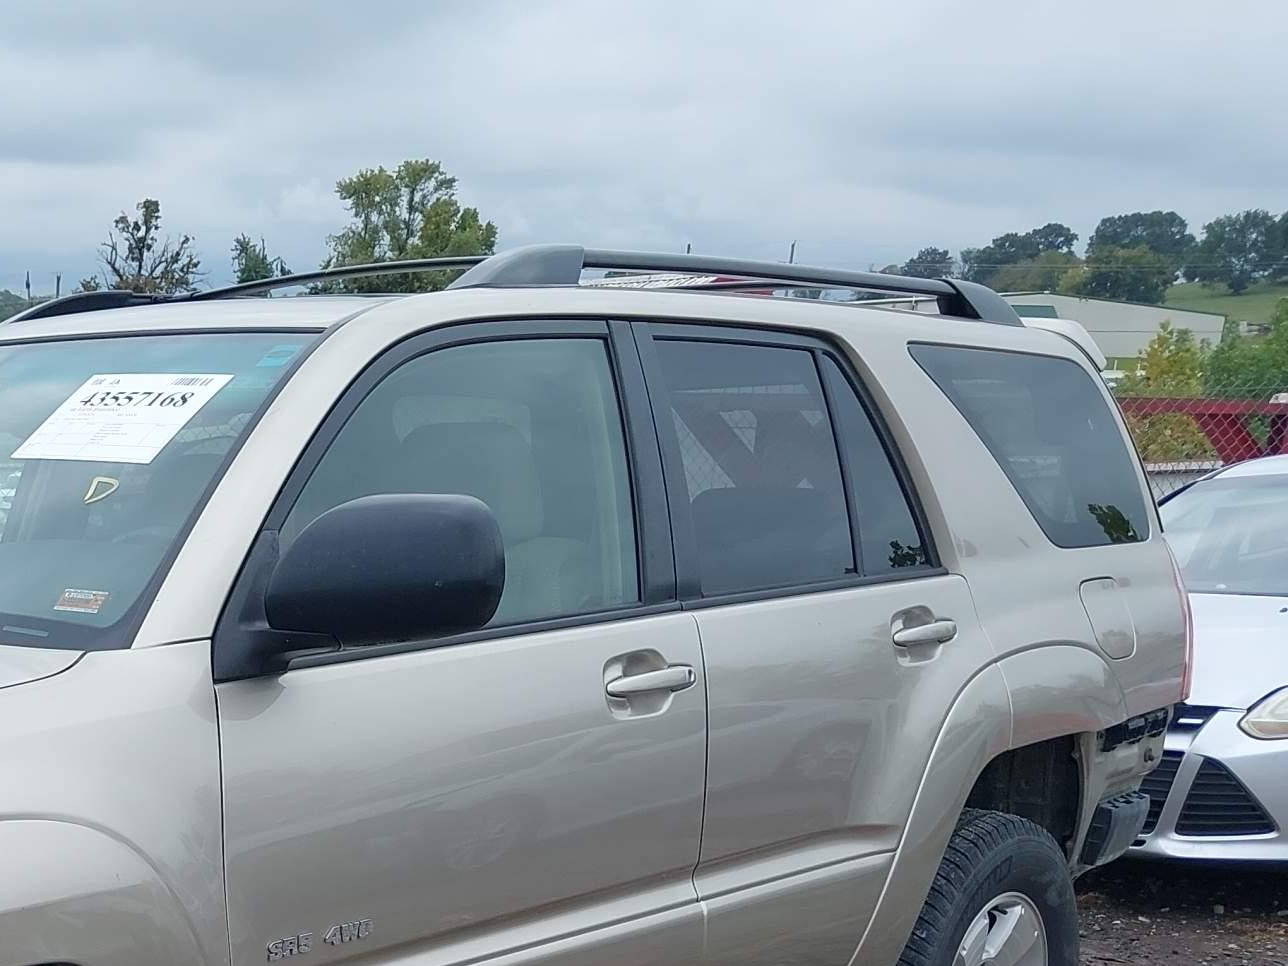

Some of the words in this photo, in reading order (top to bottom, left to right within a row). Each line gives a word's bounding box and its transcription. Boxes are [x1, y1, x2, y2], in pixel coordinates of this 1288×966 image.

[79, 391, 195, 408] 43557168
[266, 932, 313, 962] SR5
[322, 918, 375, 946] 4WD
